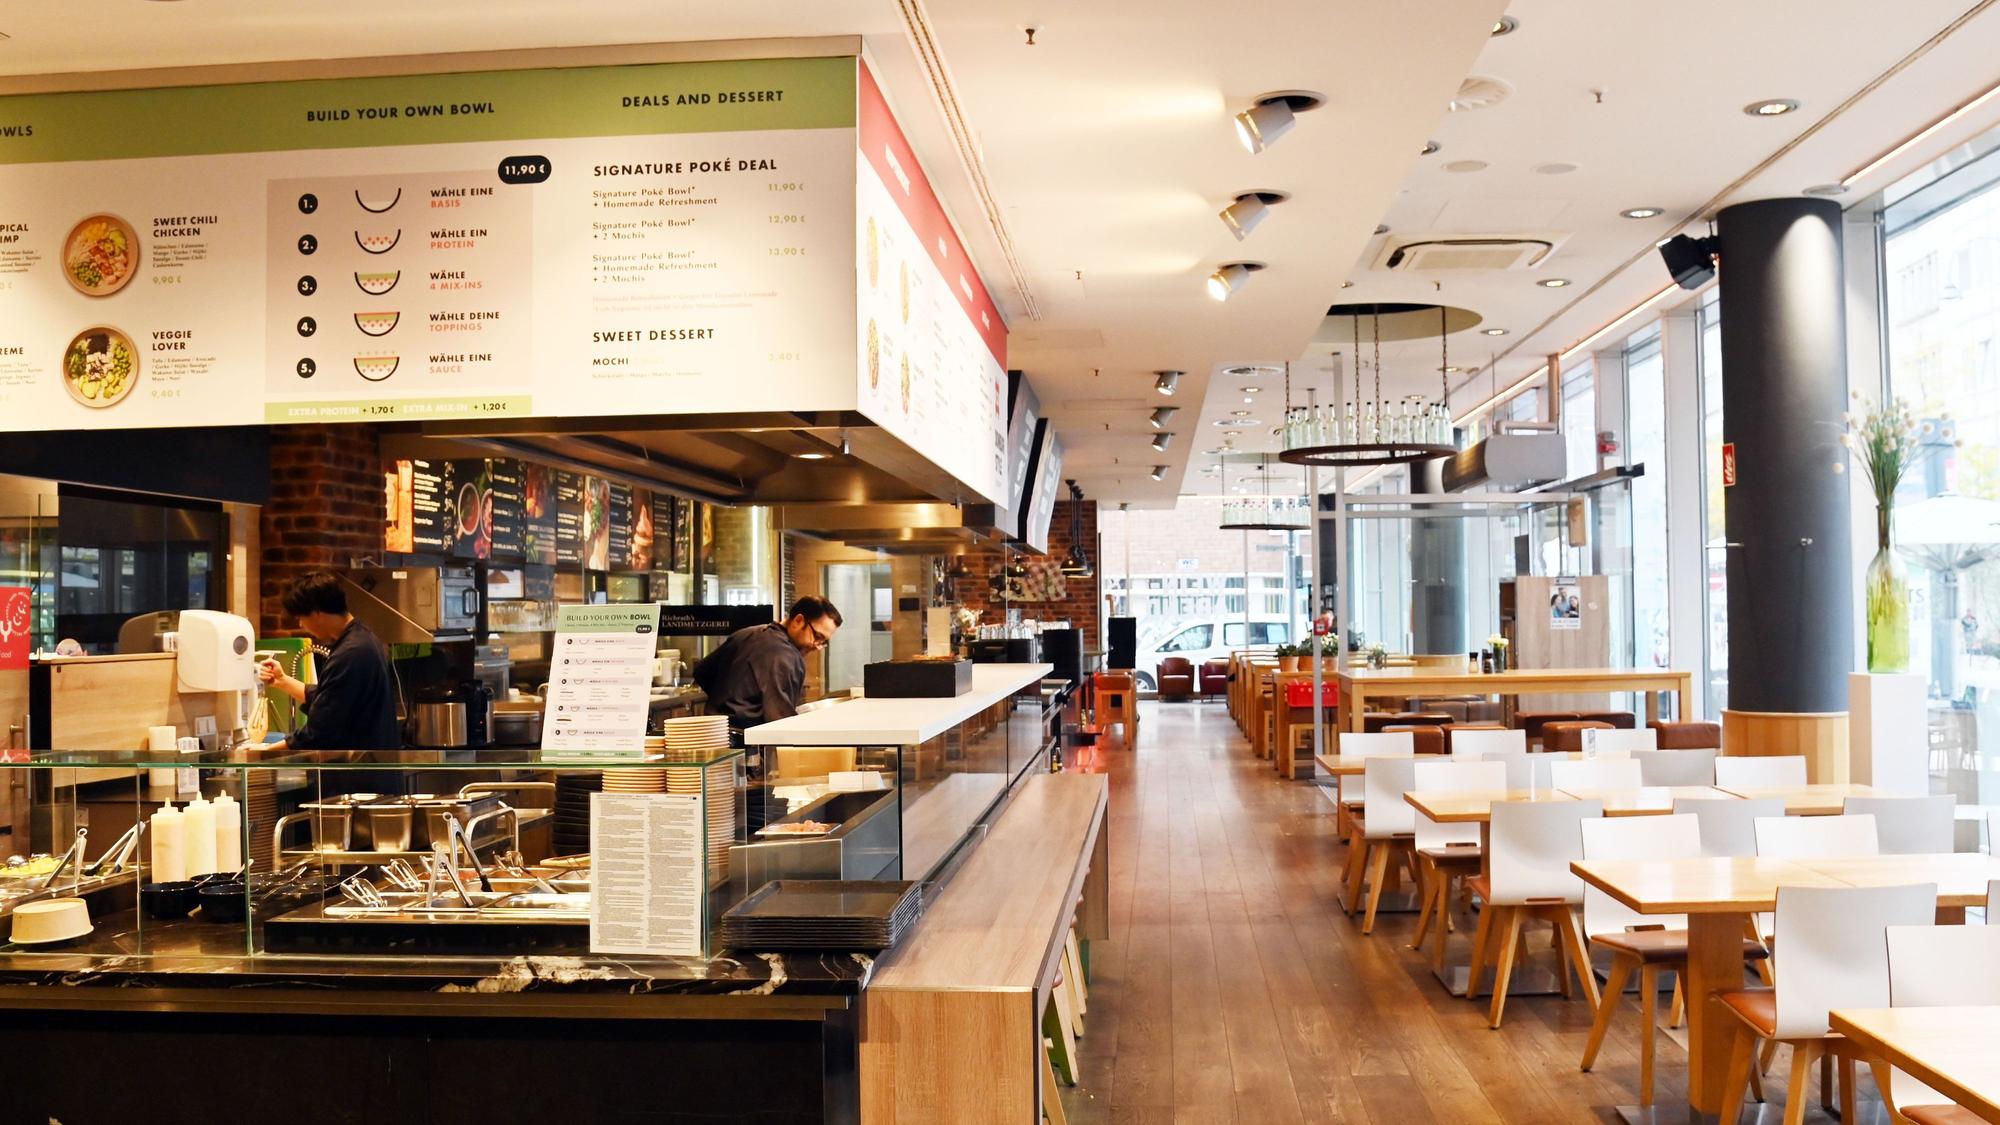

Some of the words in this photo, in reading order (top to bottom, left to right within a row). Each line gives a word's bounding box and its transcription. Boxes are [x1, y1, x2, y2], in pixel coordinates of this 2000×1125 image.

[621, 94, 670, 108] DEALS
[676, 93, 711, 105] AND
[717, 90, 784, 104] DESSERT
[307, 110, 350, 122] BUILD
[356, 107, 399, 120] YOUR
[404, 104, 443, 117] OWN
[450, 102, 495, 116] BOWL
[505, 164, 536, 176] 11,90
[593, 162, 683, 177] SIGNATURE
[689, 157, 731, 173] POKÉ
[738, 159, 777, 171] DEAL
[430, 187, 466, 198] WÄHLE
[470, 187, 494, 196] EINE
[592, 190, 637, 200] Signature
[303, 199, 313, 209] 1.
[430, 199, 461, 209] BASIS
[603, 199, 655, 208] Homemade
[658, 197, 718, 206] Refreshment
[153, 216, 187, 227] SWEET
[190, 215, 218, 225] CHILI
[592, 221, 637, 232] Signature
[153, 227, 201, 238] CHICKEN
[430, 229, 466, 239] WÄHLE
[470, 228, 488, 237] EIN
[612, 232, 646, 240] Mochis
[302, 240, 314, 250] 2.
[430, 240, 474, 249] PROTEIN
[592, 254, 637, 263] Signature
[603, 263, 654, 272] Homemade
[658, 261, 718, 270] Refreshment
[430, 270, 465, 280] WÄHLE
[612, 275, 646, 283] Mochis
[301, 281, 313, 291] 3.
[430, 282, 436, 290] 4
[440, 281, 482, 290] MIX-INS
[429, 310, 465, 322] WÄHLE
[469, 310, 500, 321] DEINE
[300, 321, 313, 332] 4.
[429, 321, 483, 332] TOPPINGS
[152, 330, 192, 340] VEGGIE
[593, 330, 642, 343] SWEET
[649, 328, 715, 341] DESSERT
[152, 341, 186, 351] LOVER
[429, 353, 465, 364] WÄHLE
[469, 353, 493, 363] EINE
[592, 357, 629, 366] MOCHI
[300, 363, 313, 374] 5.
[429, 364, 463, 375] SAUCE
[287, 407, 317, 417] EXTRA
[320, 406, 359, 416] PROTEIN
[370, 406, 388, 415] 1,70
[403, 403, 432, 414] EXTRA
[482, 403, 500, 412] 1,20
